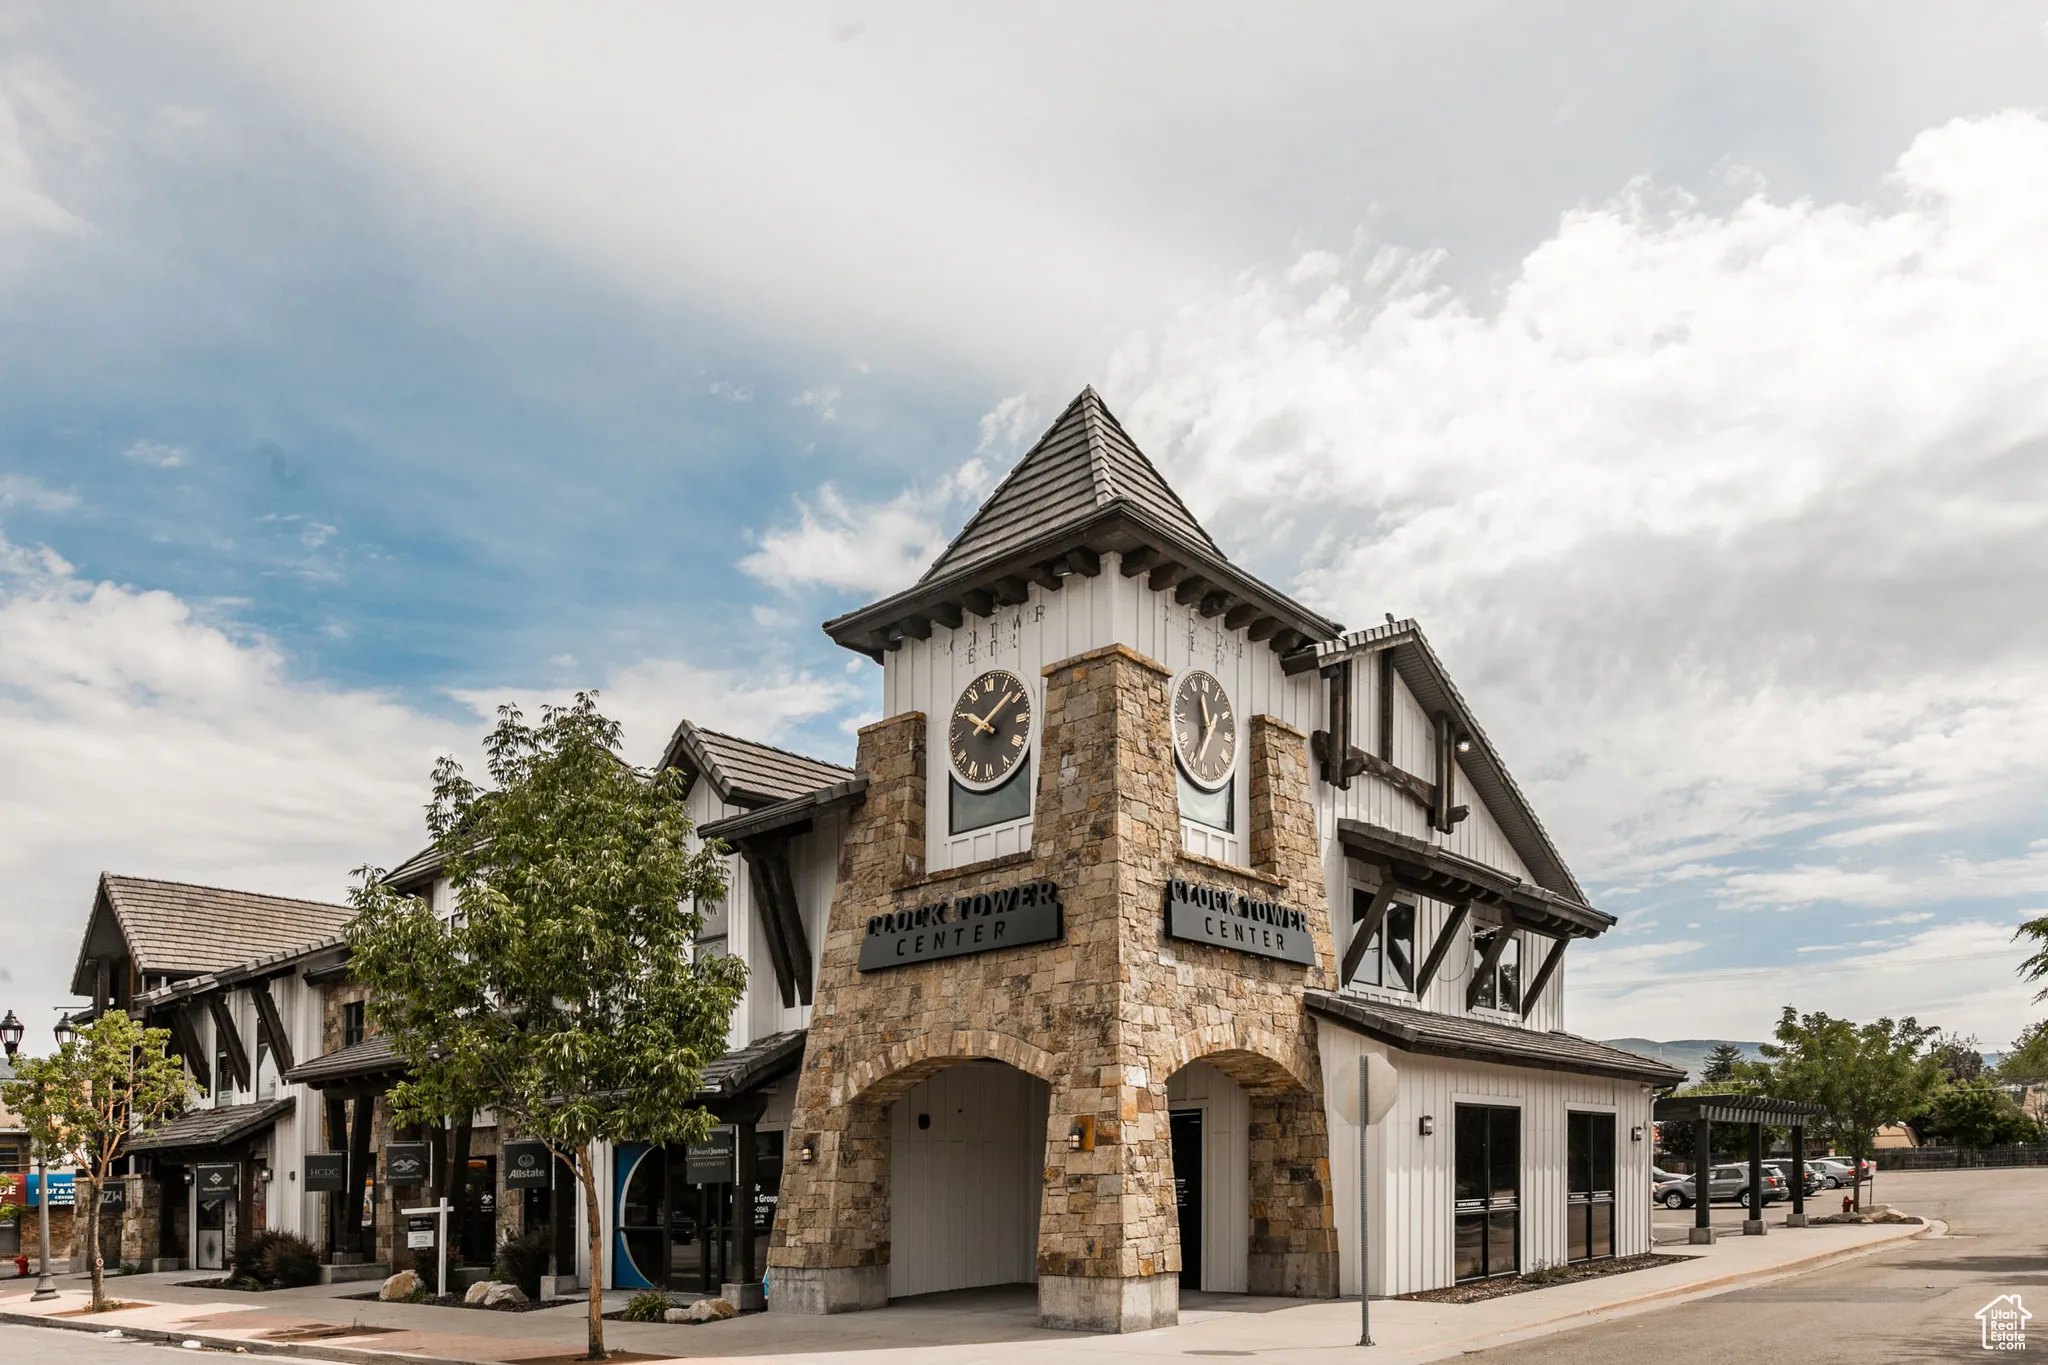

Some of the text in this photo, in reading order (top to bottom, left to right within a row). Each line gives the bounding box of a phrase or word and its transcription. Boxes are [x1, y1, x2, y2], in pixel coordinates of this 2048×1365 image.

[867, 881, 1056, 936] CLOCK TOWER
[1171, 879, 1308, 933] CLOCK TOWER
[896, 920, 1006, 956] CENTER
[1205, 916, 1285, 951] CENTER
[310, 1168, 339, 1176] HCDC
[509, 1168, 545, 1179] Allstate
[759, 1194, 778, 1204] Group
